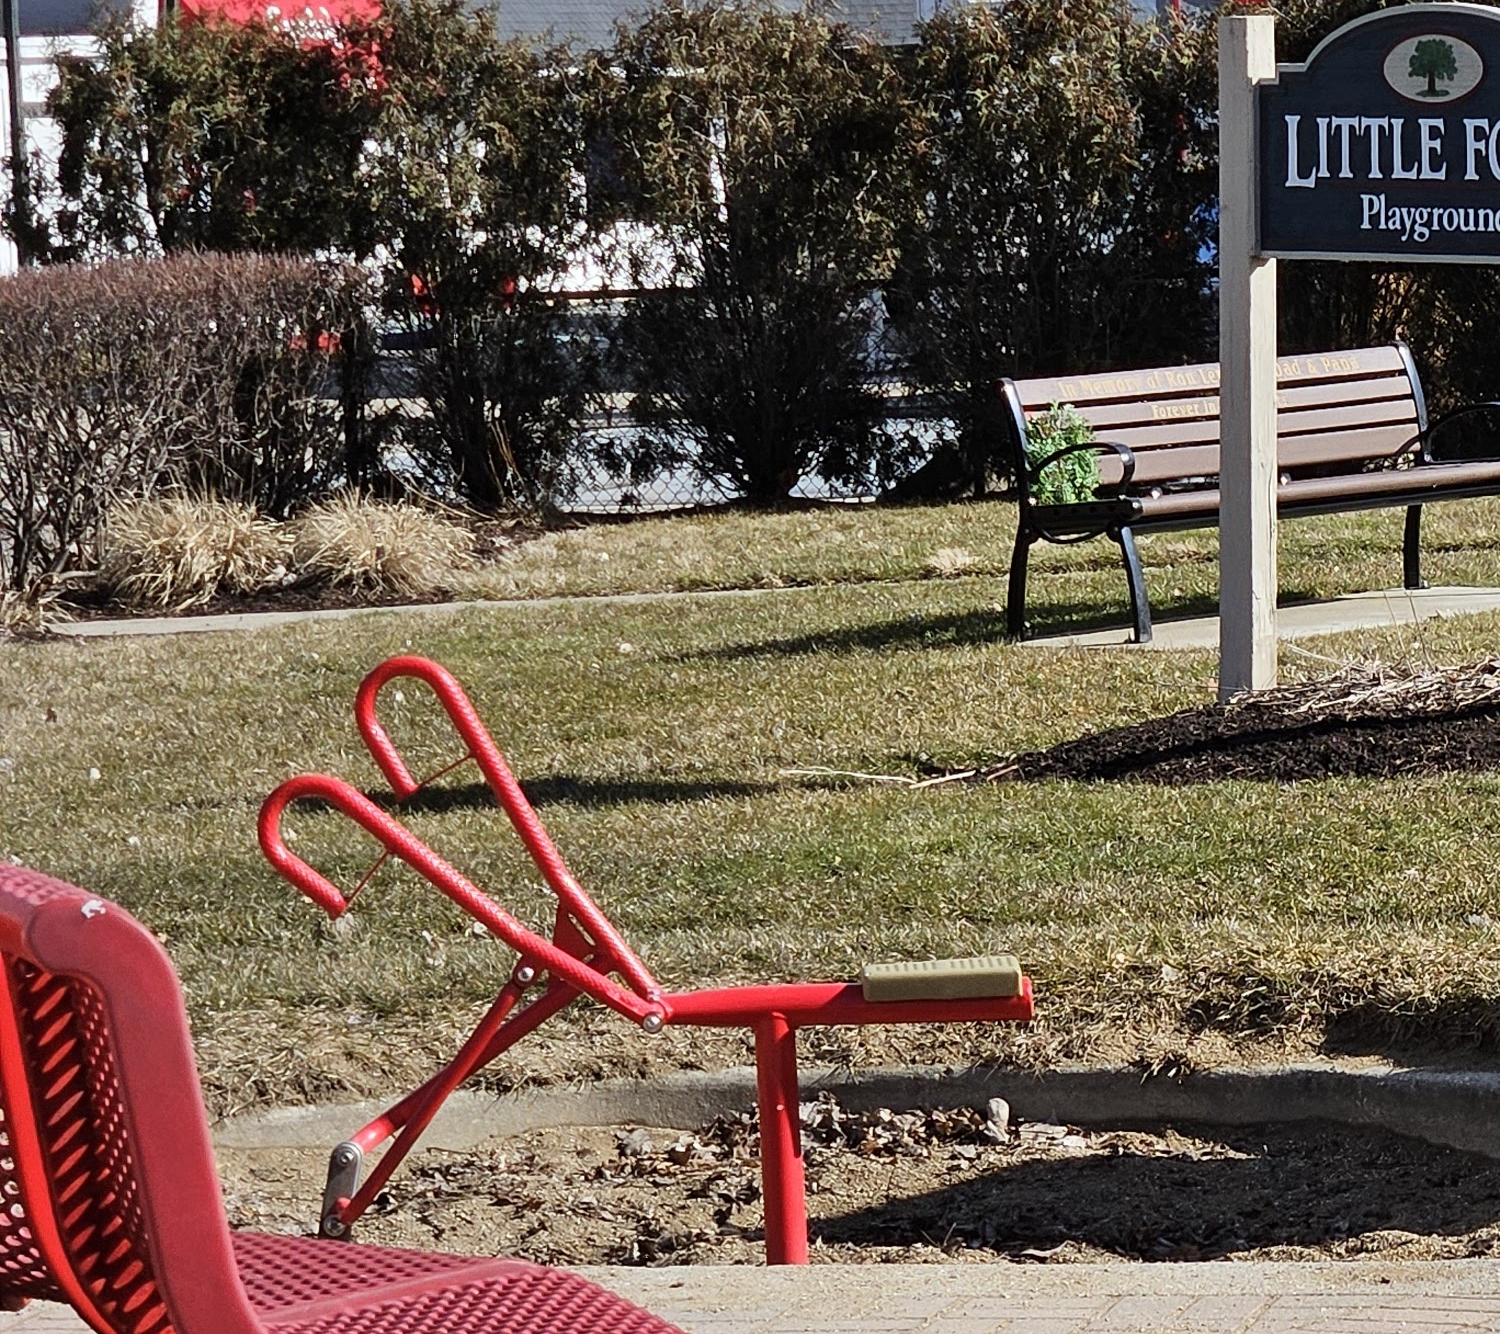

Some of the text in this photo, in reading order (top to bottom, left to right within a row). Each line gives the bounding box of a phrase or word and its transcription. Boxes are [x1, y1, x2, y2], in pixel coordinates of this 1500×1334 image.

[1285, 115, 1447, 189] LITTLE
[1056, 380, 1077, 397] In
[1079, 376, 1141, 395] Memory
[1147, 370, 1162, 388] of
[1165, 370, 1197, 387] Ron
[1306, 358, 1318, 374] &
[1151, 402, 1200, 418] Forever
